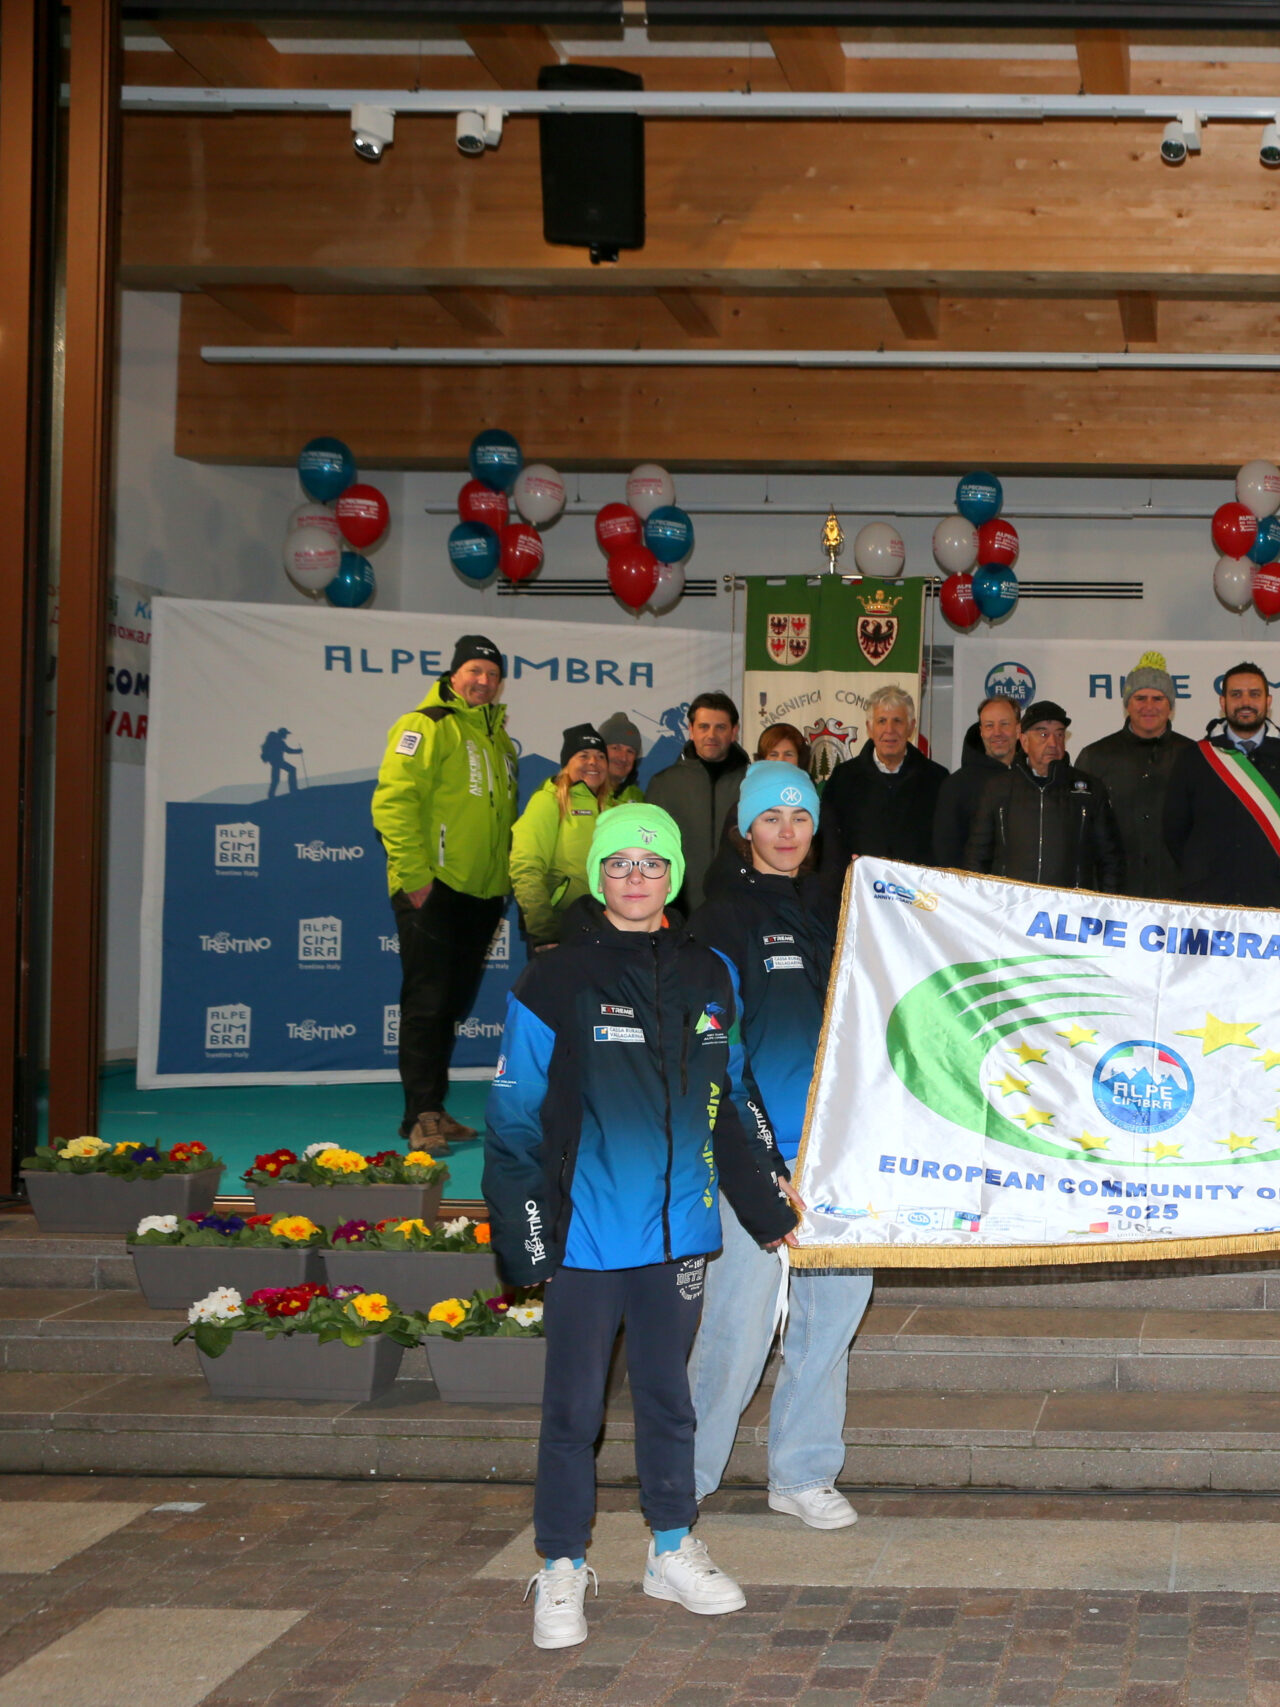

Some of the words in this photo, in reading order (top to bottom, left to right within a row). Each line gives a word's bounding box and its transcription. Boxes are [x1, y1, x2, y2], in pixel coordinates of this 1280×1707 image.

[324, 645, 442, 677] ALPE
[500, 653, 654, 689] IMBRA
[994, 685, 1025, 694] ALPE
[1089, 674, 1192, 699] AE
[219, 829, 256, 838] ALPE
[220, 841, 256, 851] CIM
[294, 842, 364, 862] TRENTINO
[219, 852, 255, 863] BRA
[303, 923, 338, 932] ALPE
[1026, 911, 1127, 948] ALPE
[199, 935, 272, 954] TRENTINO
[303, 935, 338, 945] CIM
[303, 947, 337, 957] BRA
[211, 1011, 247, 1020] ALPE
[211, 1024, 247, 1033] CIM
[286, 1023, 356, 1041] TRENTINO
[454, 1022, 505, 1038] TRENTIN
[210, 1035, 246, 1045] BRA
[1113, 1082, 1173, 1100] ALPE
[706, 1081, 721, 1131] Alpe
[1112, 1095, 1172, 1110] CIMBRA
[878, 1154, 1045, 1191] EUROPEAN
[1057, 1177, 1244, 1200] COMMUNITY
[1107, 1203, 1179, 1220] 2025
[525, 1200, 546, 1265] TRENTINO
